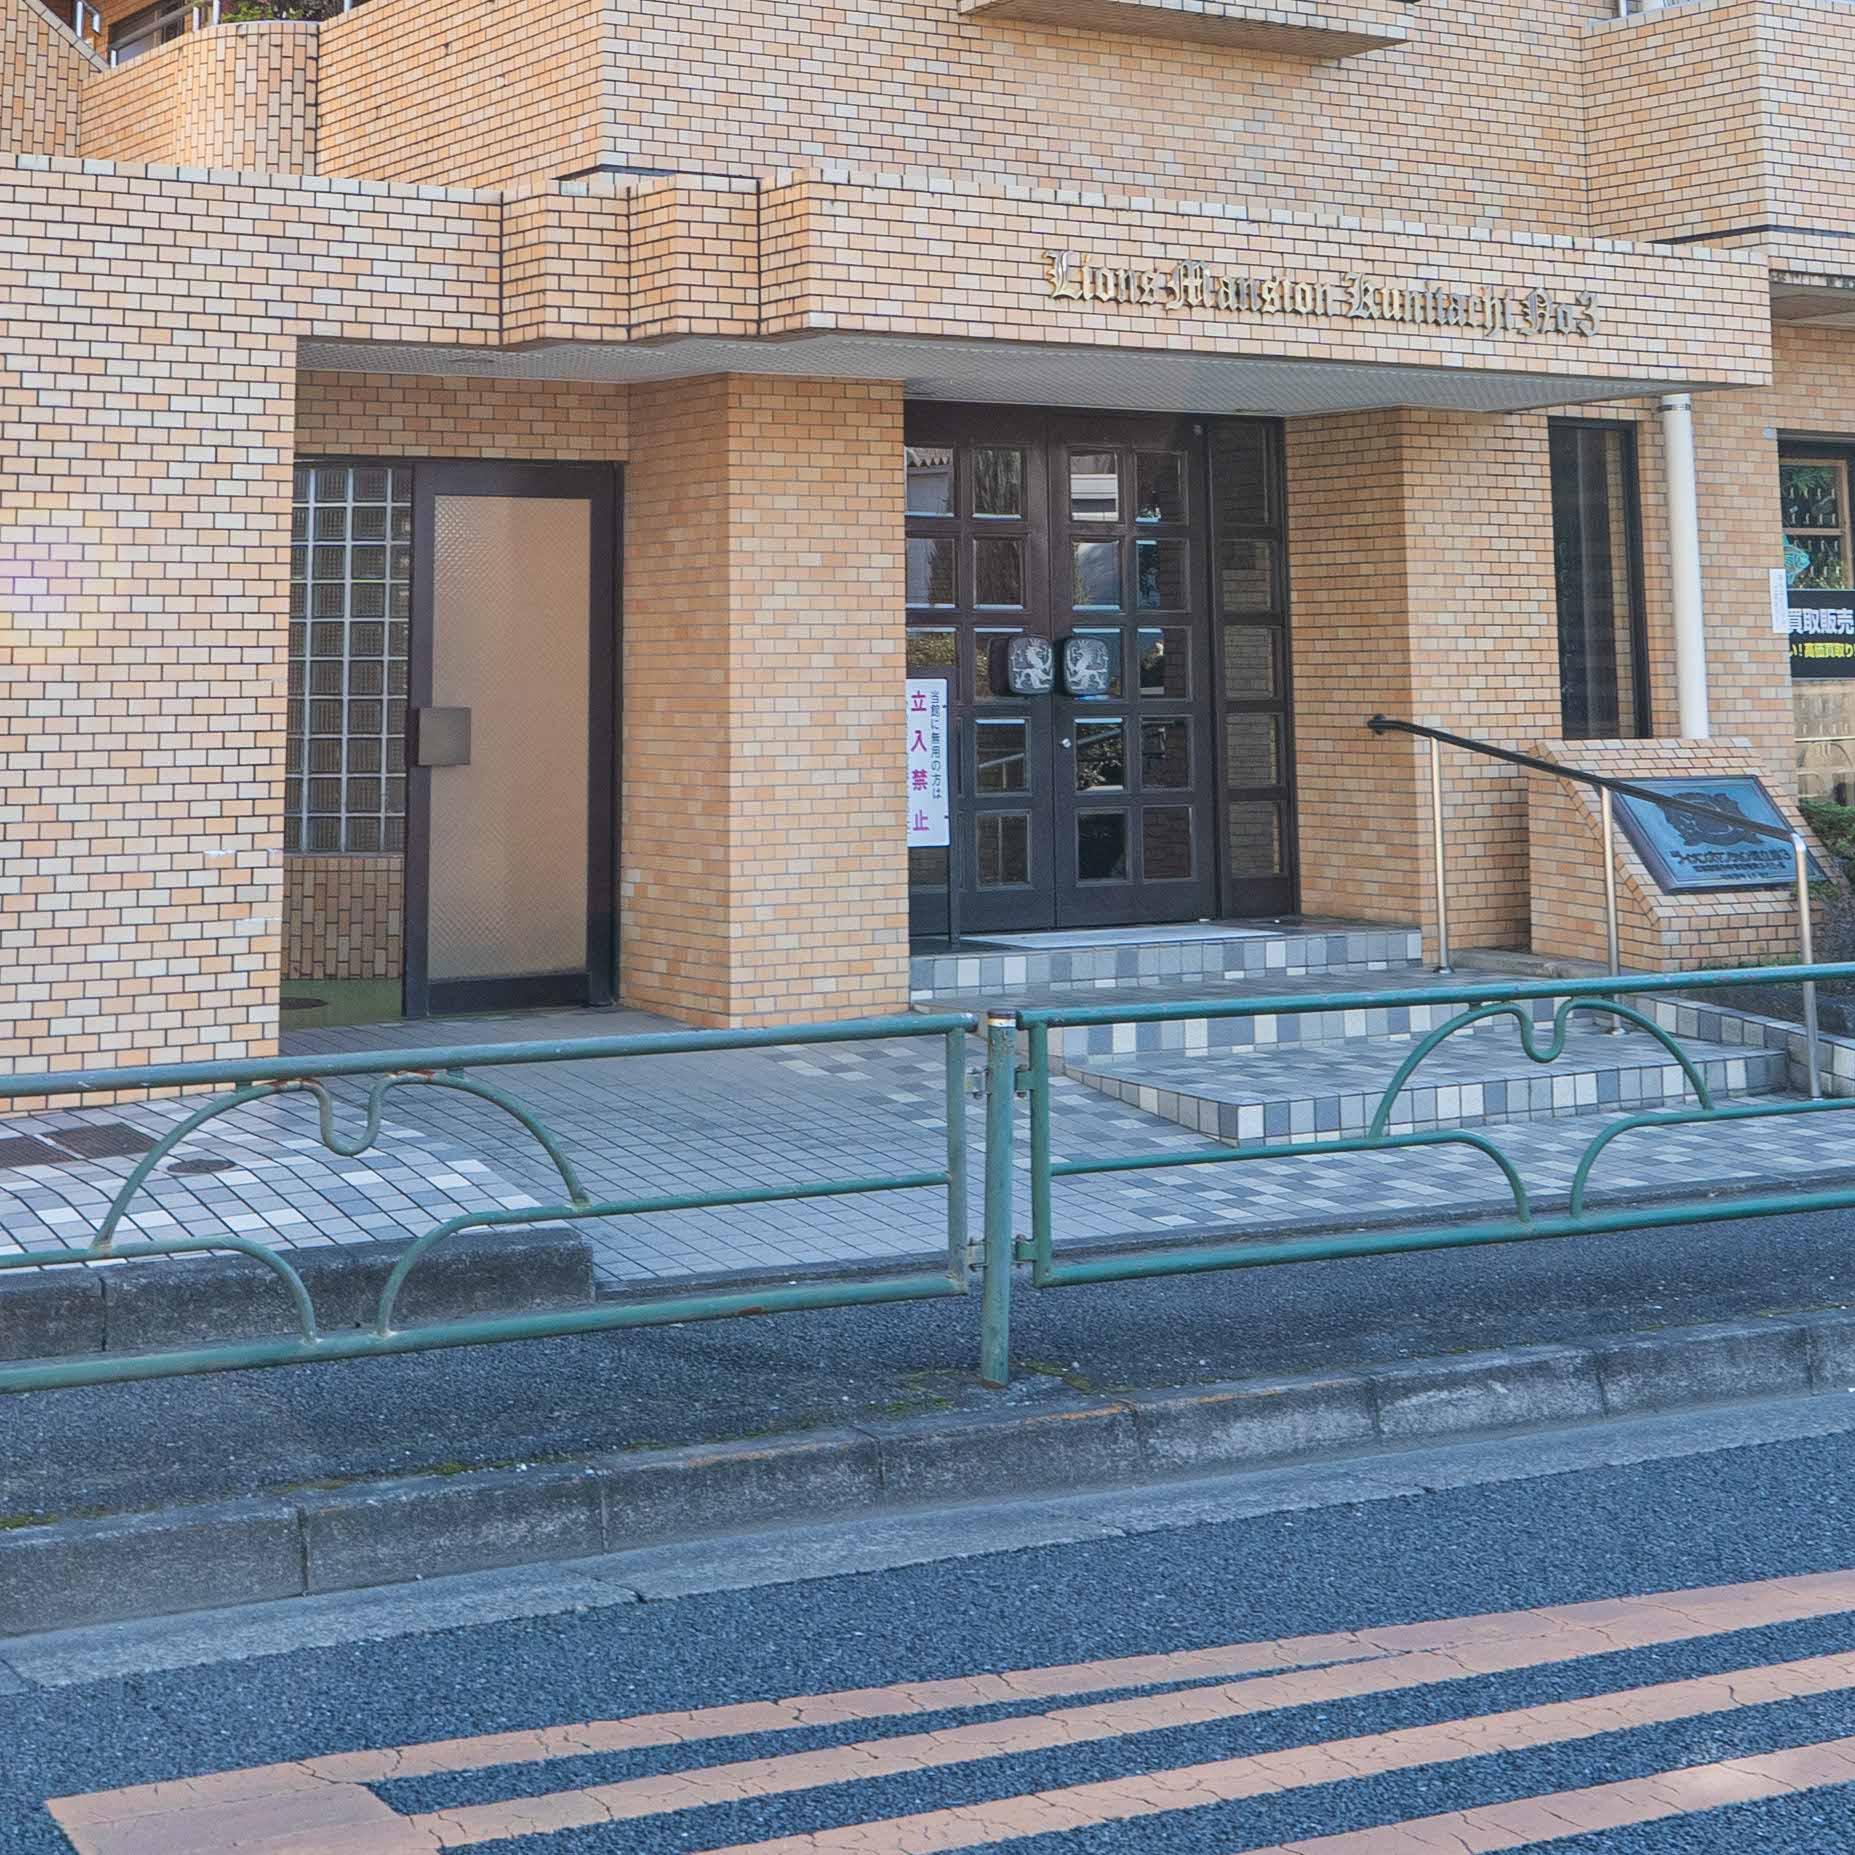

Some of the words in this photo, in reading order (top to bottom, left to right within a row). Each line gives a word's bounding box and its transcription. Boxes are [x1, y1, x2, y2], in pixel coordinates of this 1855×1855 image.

[1042, 249, 1158, 305] Lions
[1164, 259, 1340, 317] Mansion
[1343, 271, 1515, 338] Kunitachi
[911, 690, 929, 832] 立入禁止
